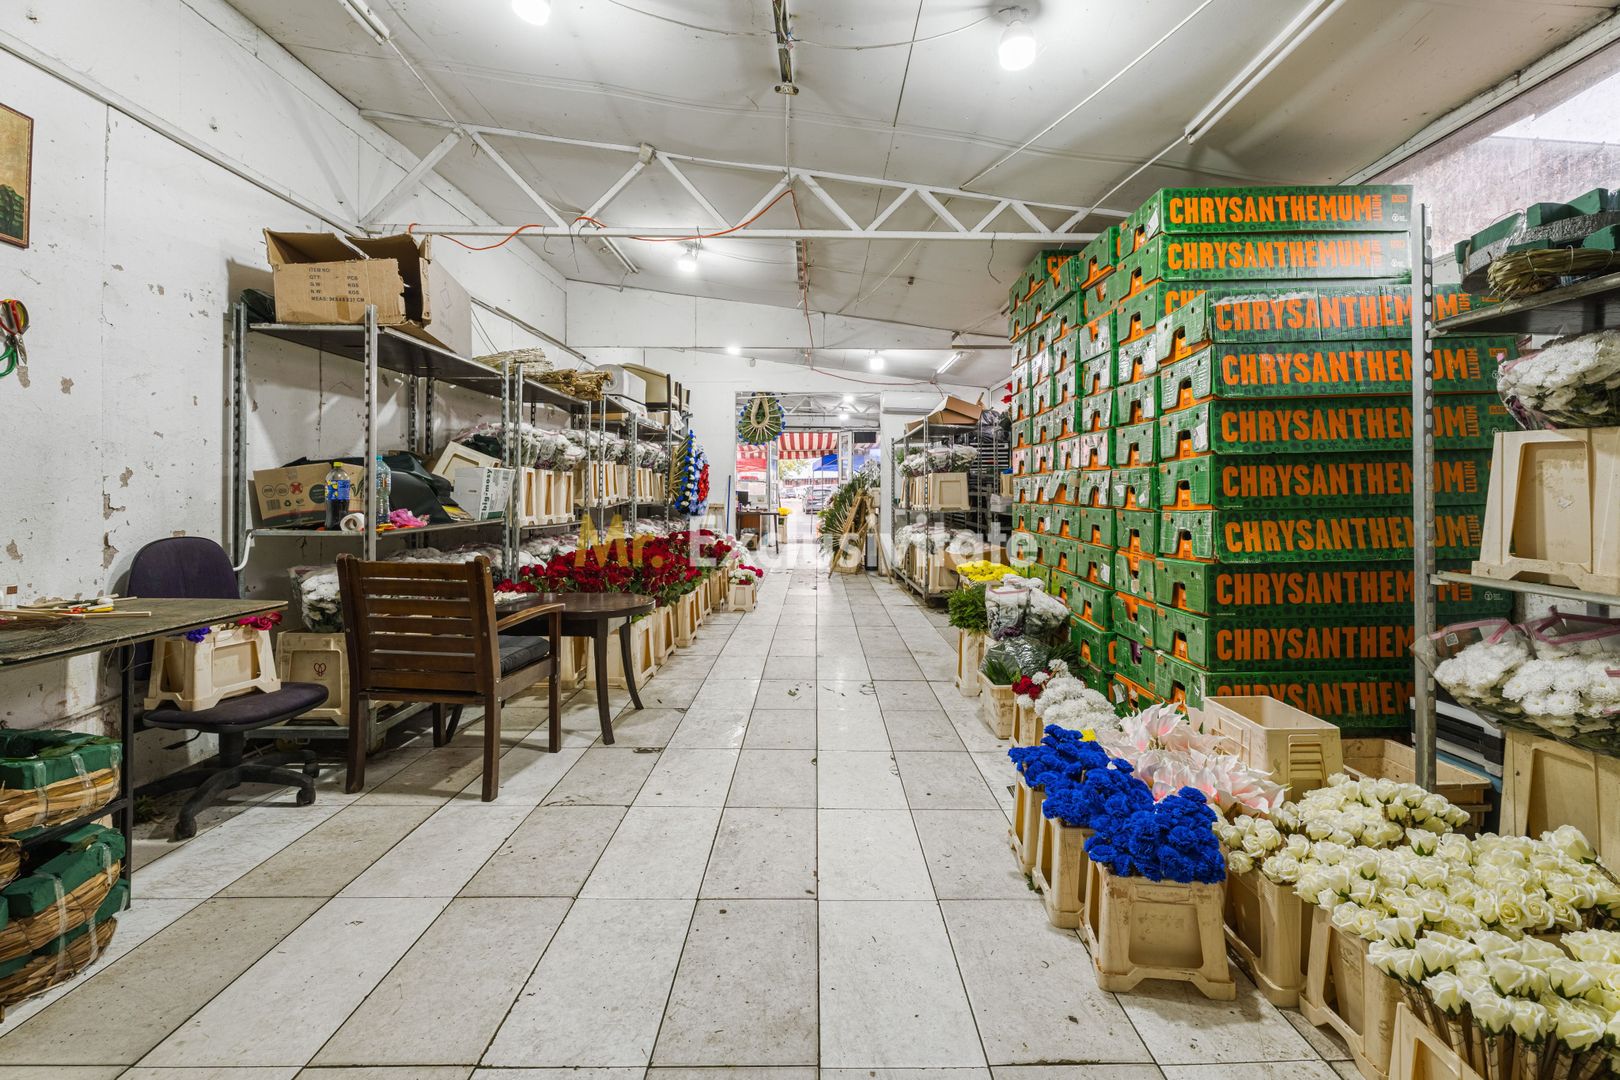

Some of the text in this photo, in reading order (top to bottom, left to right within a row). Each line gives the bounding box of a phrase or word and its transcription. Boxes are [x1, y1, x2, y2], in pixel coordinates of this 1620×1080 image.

[1168, 194, 1371, 224] CHRYSANTHEMUM
[1167, 240, 1371, 270] CHRYSANTHEMUM
[1215, 293, 1459, 331] CHRYSANTHEMM
[1215, 570, 1460, 605] CHRYSANTHEM
[1216, 626, 1415, 660] CHRYSANTHEM
